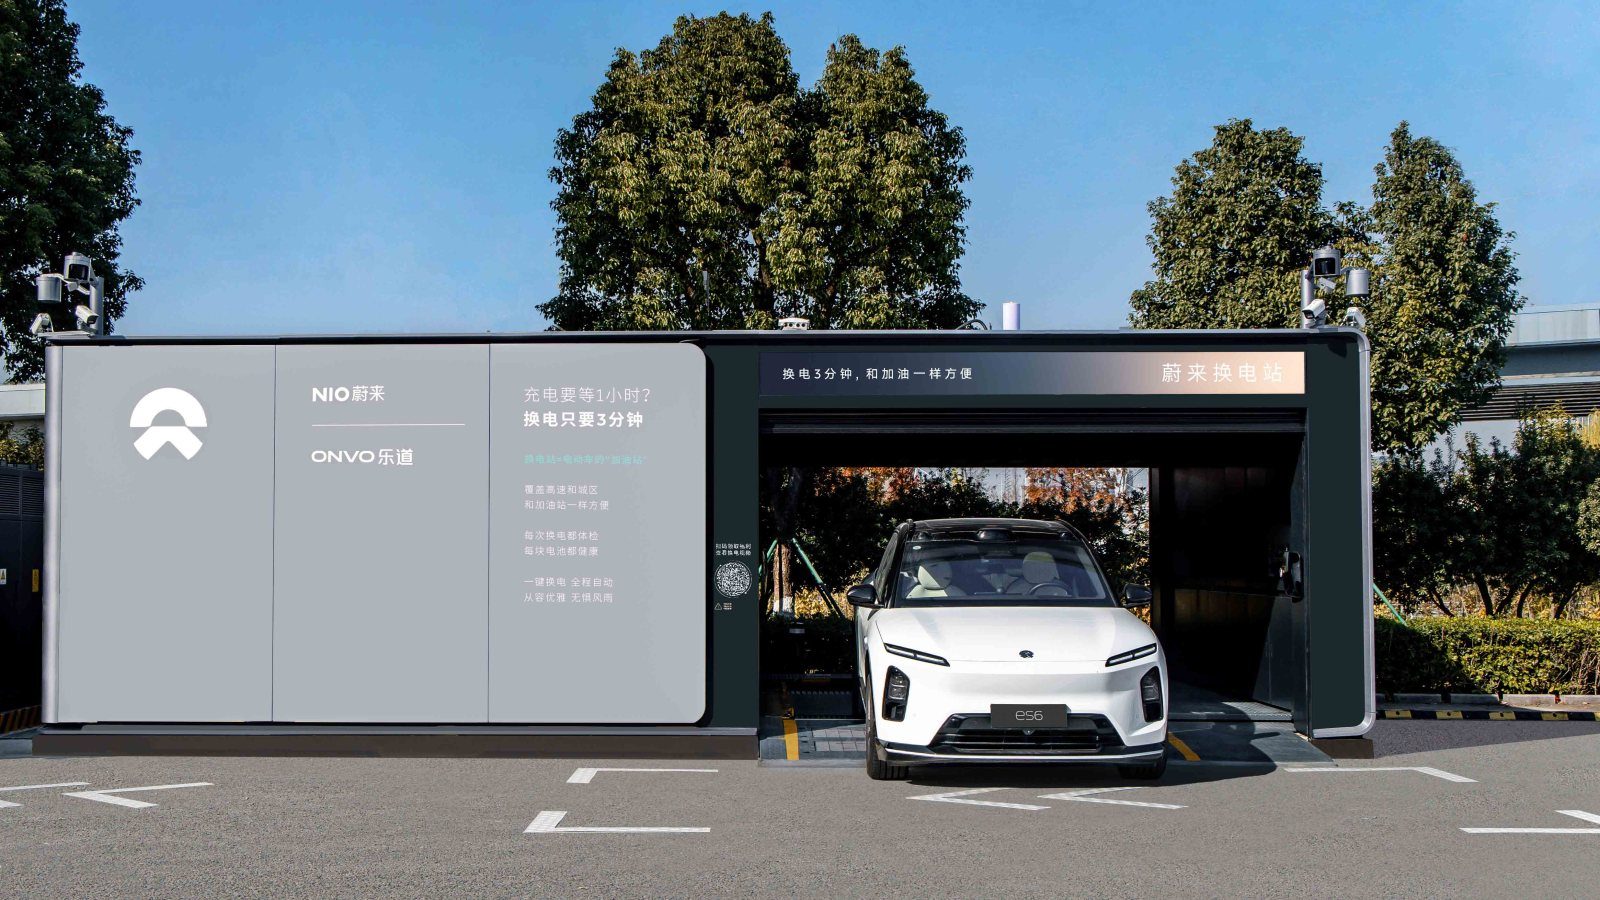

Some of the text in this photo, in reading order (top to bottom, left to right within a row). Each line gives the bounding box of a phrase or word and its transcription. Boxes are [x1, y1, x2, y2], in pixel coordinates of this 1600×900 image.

[1161, 362, 1284, 383] 蔚来换电站
[523, 411, 643, 428] 换电只要3分钟
[524, 484, 599, 495] 覆盖高速和城区
[524, 500, 609, 511] 和加油站一样方便
[524, 530, 599, 541] 每次换电都体检
[524, 546, 599, 557] 每块电池都健康
[524, 577, 613, 588] 一键换电 全程自动
[524, 592, 566, 603] 从容优雅
